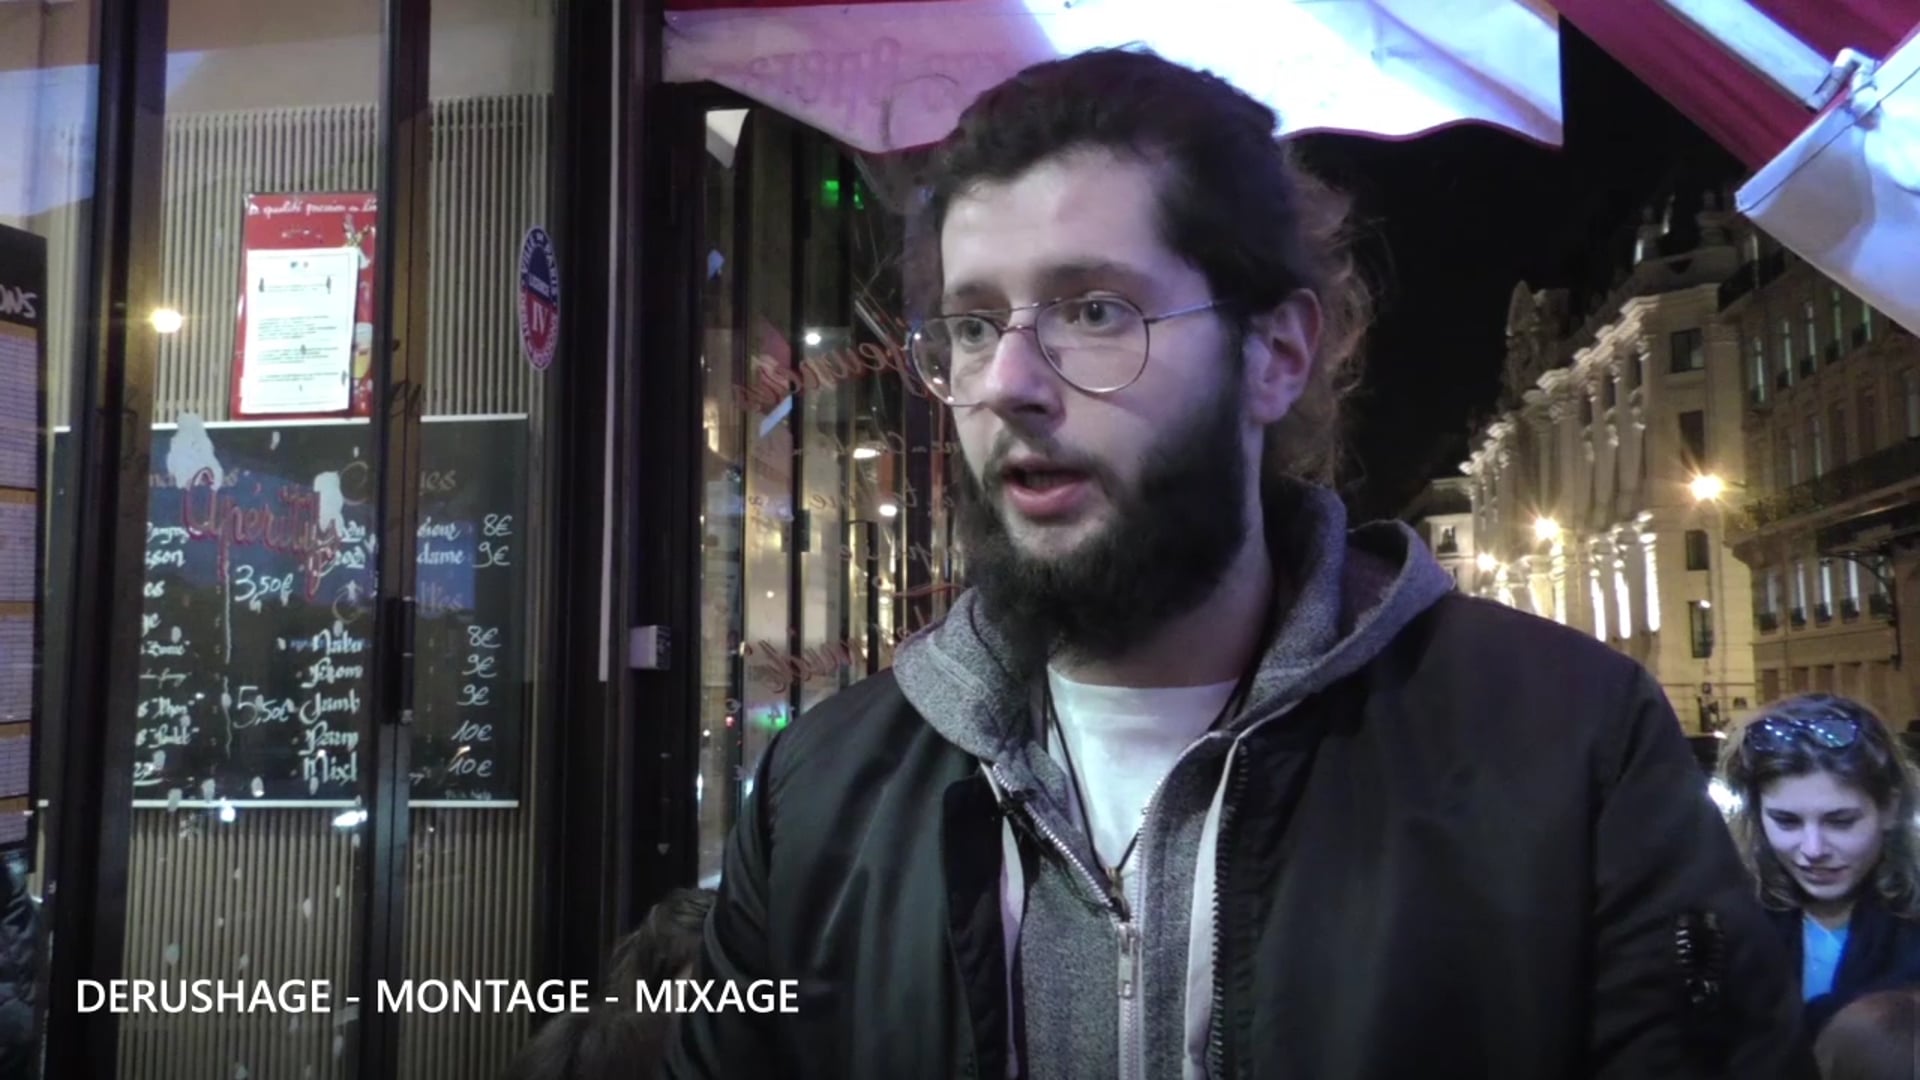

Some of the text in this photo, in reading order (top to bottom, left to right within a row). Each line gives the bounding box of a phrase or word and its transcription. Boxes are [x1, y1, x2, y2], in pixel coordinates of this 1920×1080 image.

[483, 513, 513, 537] 8€
[472, 541, 511, 568] 9€
[467, 625, 502, 648] 8€
[461, 653, 498, 678] 9€
[456, 684, 490, 706] 9€
[451, 720, 492, 742] 10€
[449, 758, 492, 777] 10€
